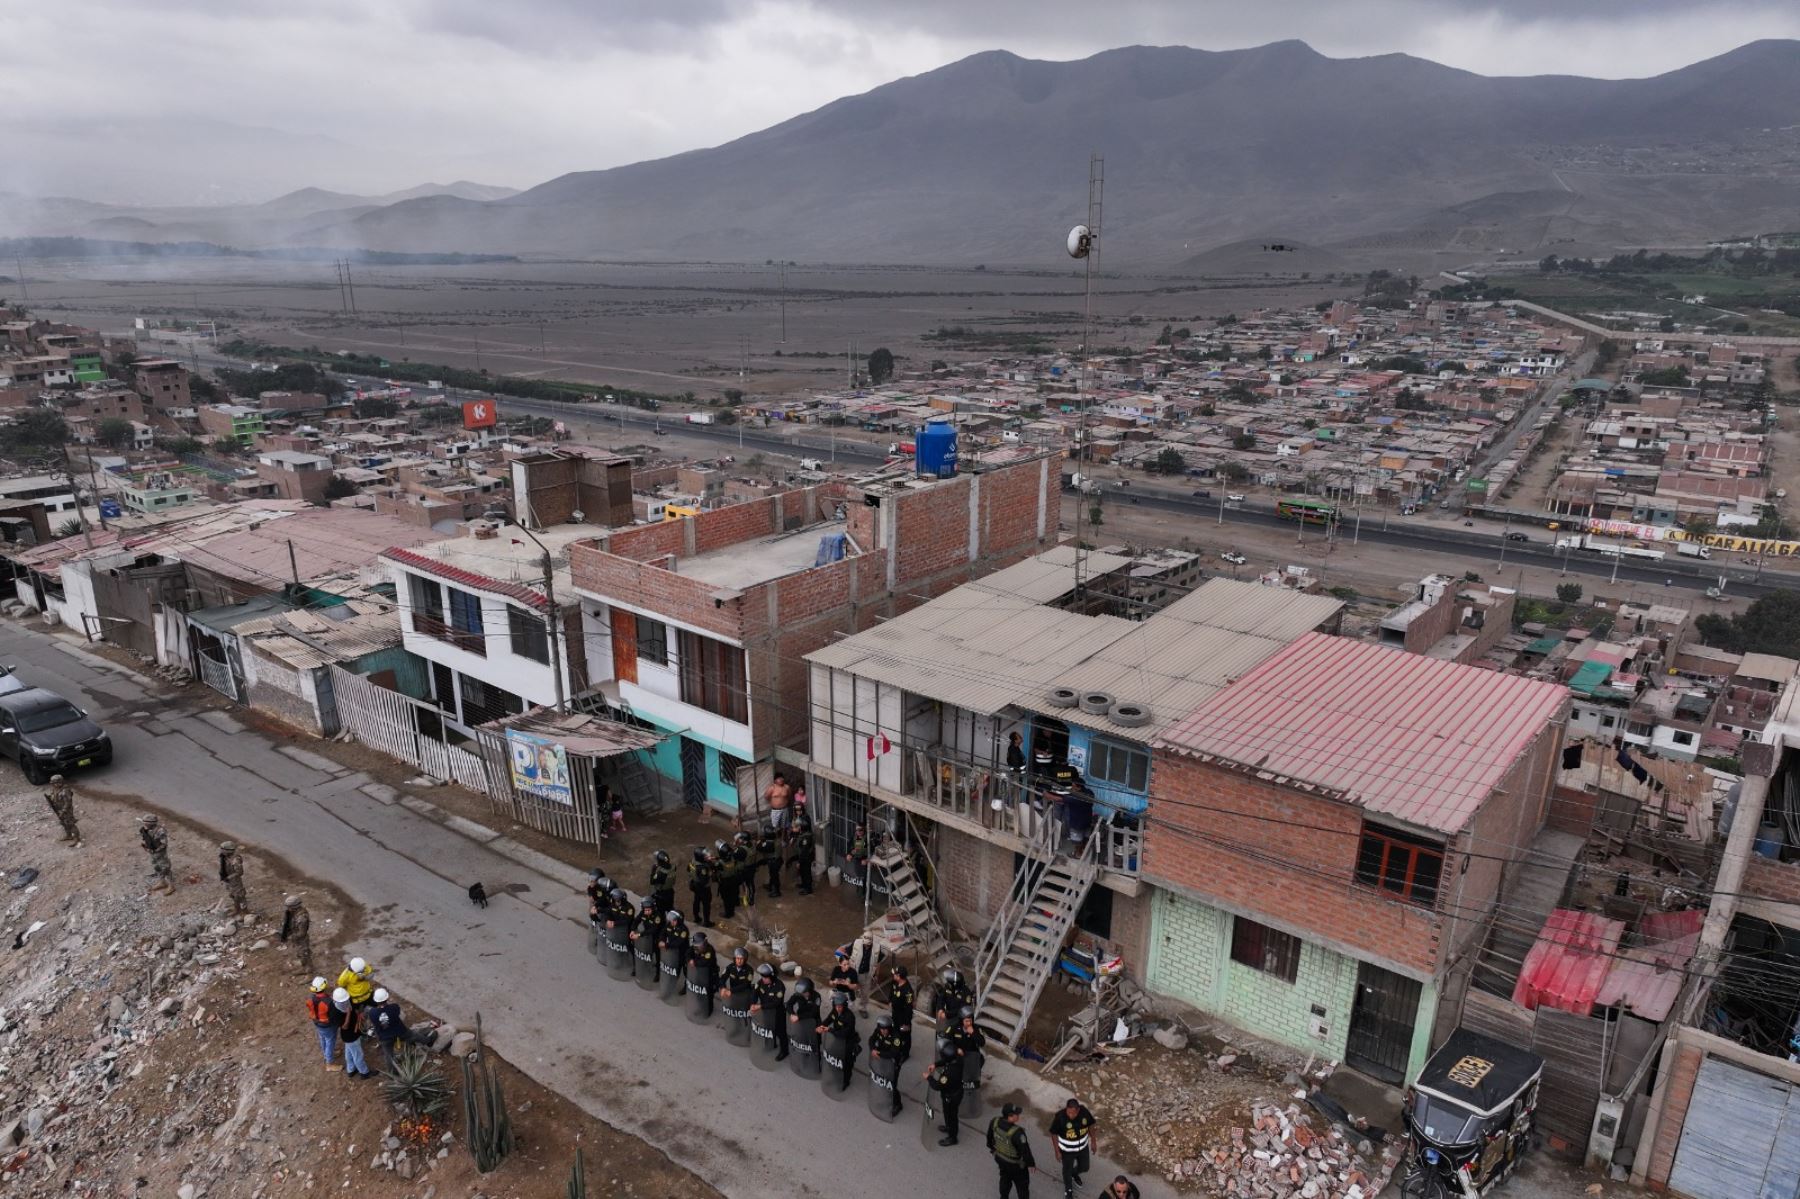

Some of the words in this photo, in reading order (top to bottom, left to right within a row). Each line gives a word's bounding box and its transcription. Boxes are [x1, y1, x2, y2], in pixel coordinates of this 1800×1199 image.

[1684, 532, 1734, 548] OSCAR
[1737, 540, 1800, 555] ALIAGA
[722, 1005, 752, 1018] POLICIA
